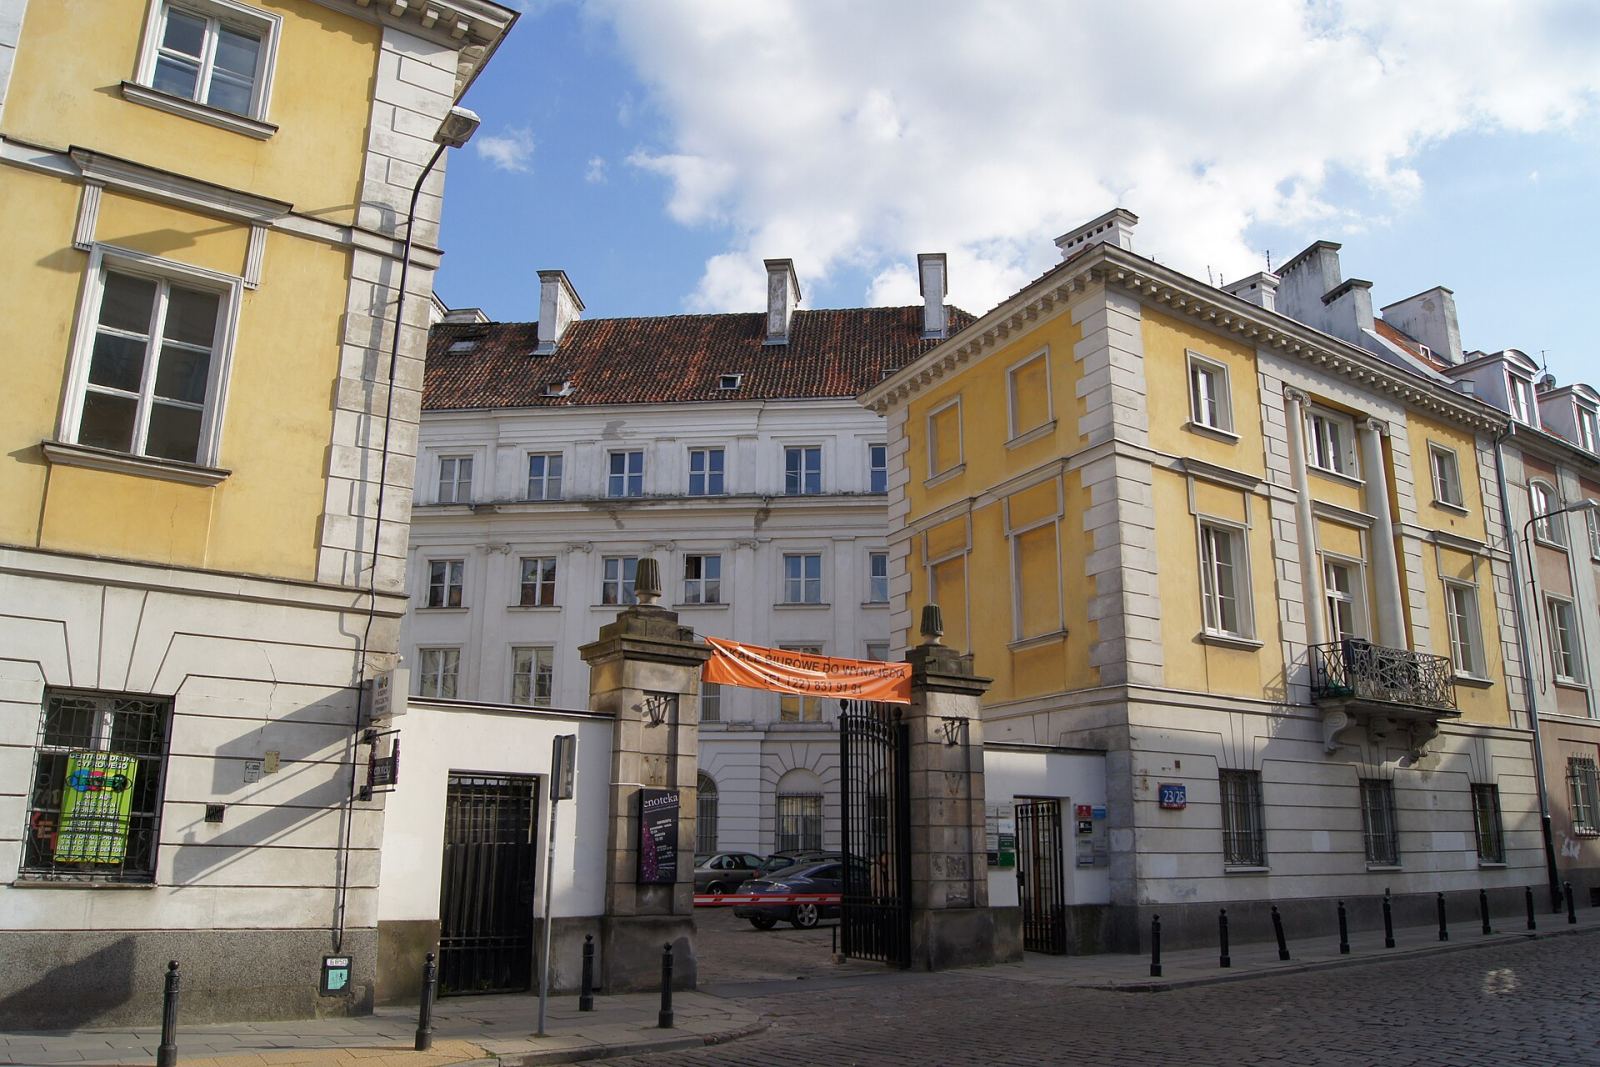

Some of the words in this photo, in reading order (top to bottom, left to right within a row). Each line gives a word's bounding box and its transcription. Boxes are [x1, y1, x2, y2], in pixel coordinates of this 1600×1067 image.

[822, 662, 839, 674] DO
[814, 681, 832, 692] 831
[836, 683, 847, 693] 91
[643, 792, 679, 808] enoteka
[1163, 790, 1186, 803] 23/25
